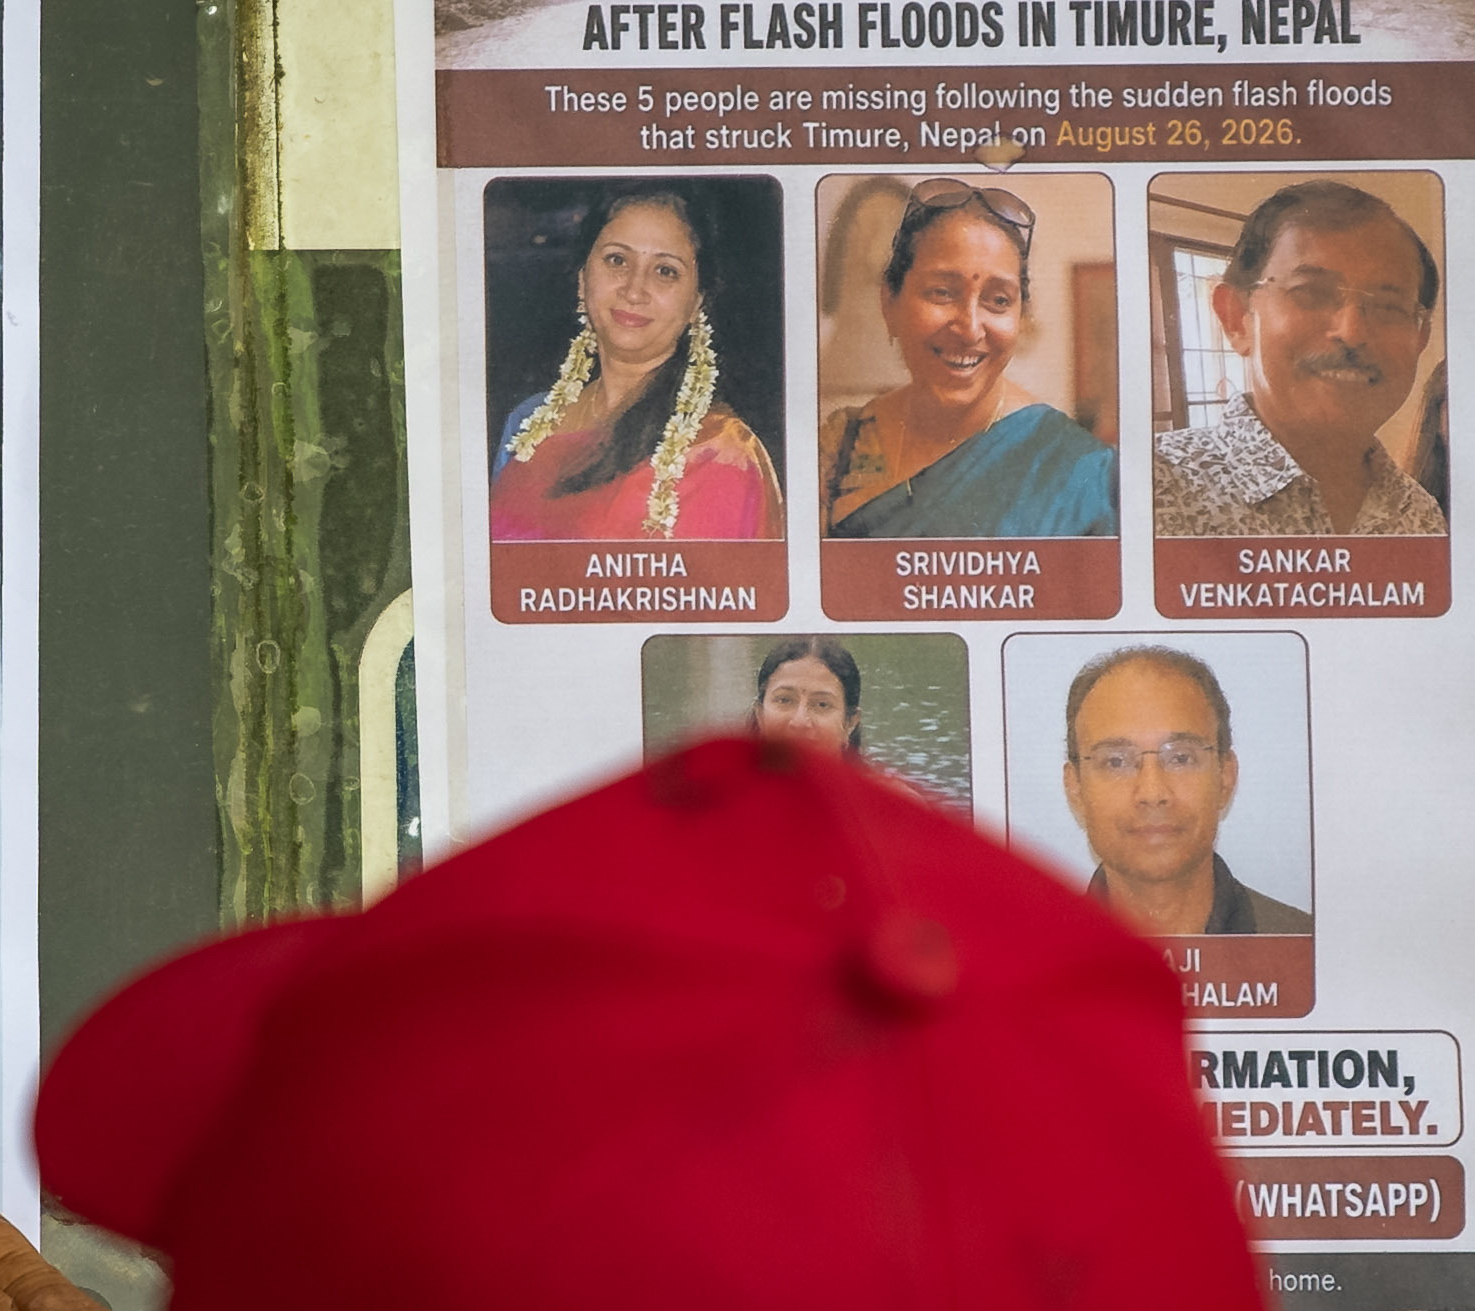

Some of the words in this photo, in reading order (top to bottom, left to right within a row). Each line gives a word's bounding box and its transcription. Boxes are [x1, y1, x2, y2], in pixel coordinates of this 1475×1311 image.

[582, 3, 708, 52] AFTER
[719, 2, 845, 51] FLASH
[857, 0, 1005, 50] FLOODS
[544, 85, 627, 112] These
[637, 85, 654, 111] 5
[665, 84, 759, 117] people
[769, 88, 812, 111] are
[822, 83, 927, 116] missing
[936, 82, 1059, 115] following
[1069, 83, 1113, 108] the
[1122, 81, 1223, 108] sudden
[1233, 80, 1297, 106] flash
[1307, 79, 1392, 106] floods
[640, 125, 696, 150] that
[705, 123, 792, 149] struck
[803, 122, 910, 152] Timure,
[920, 119, 1001, 153] Nepal
[1012, 126, 1046, 147] on
[1056, 120, 1157, 152] August
[1166, 120, 1210, 151] 26,
[1221, 118, 1301, 145] 2026.
[586, 551, 687, 578] ANITHA
[895, 550, 1042, 578] SRIVIDHYA
[1237, 548, 1351, 574] SANKAR
[519, 584, 757, 613] RADHAKRISHNAN
[903, 583, 1036, 611] SHANKAR
[1180, 581, 1426, 609] VENKATACHALAM
[1182, 982, 1279, 1007] HALAM
[1190, 1048, 1415, 1096] RMATION,
[1236, 1179, 1441, 1224] (WHATSAPP)
[1270, 1268, 1343, 1293] home.
